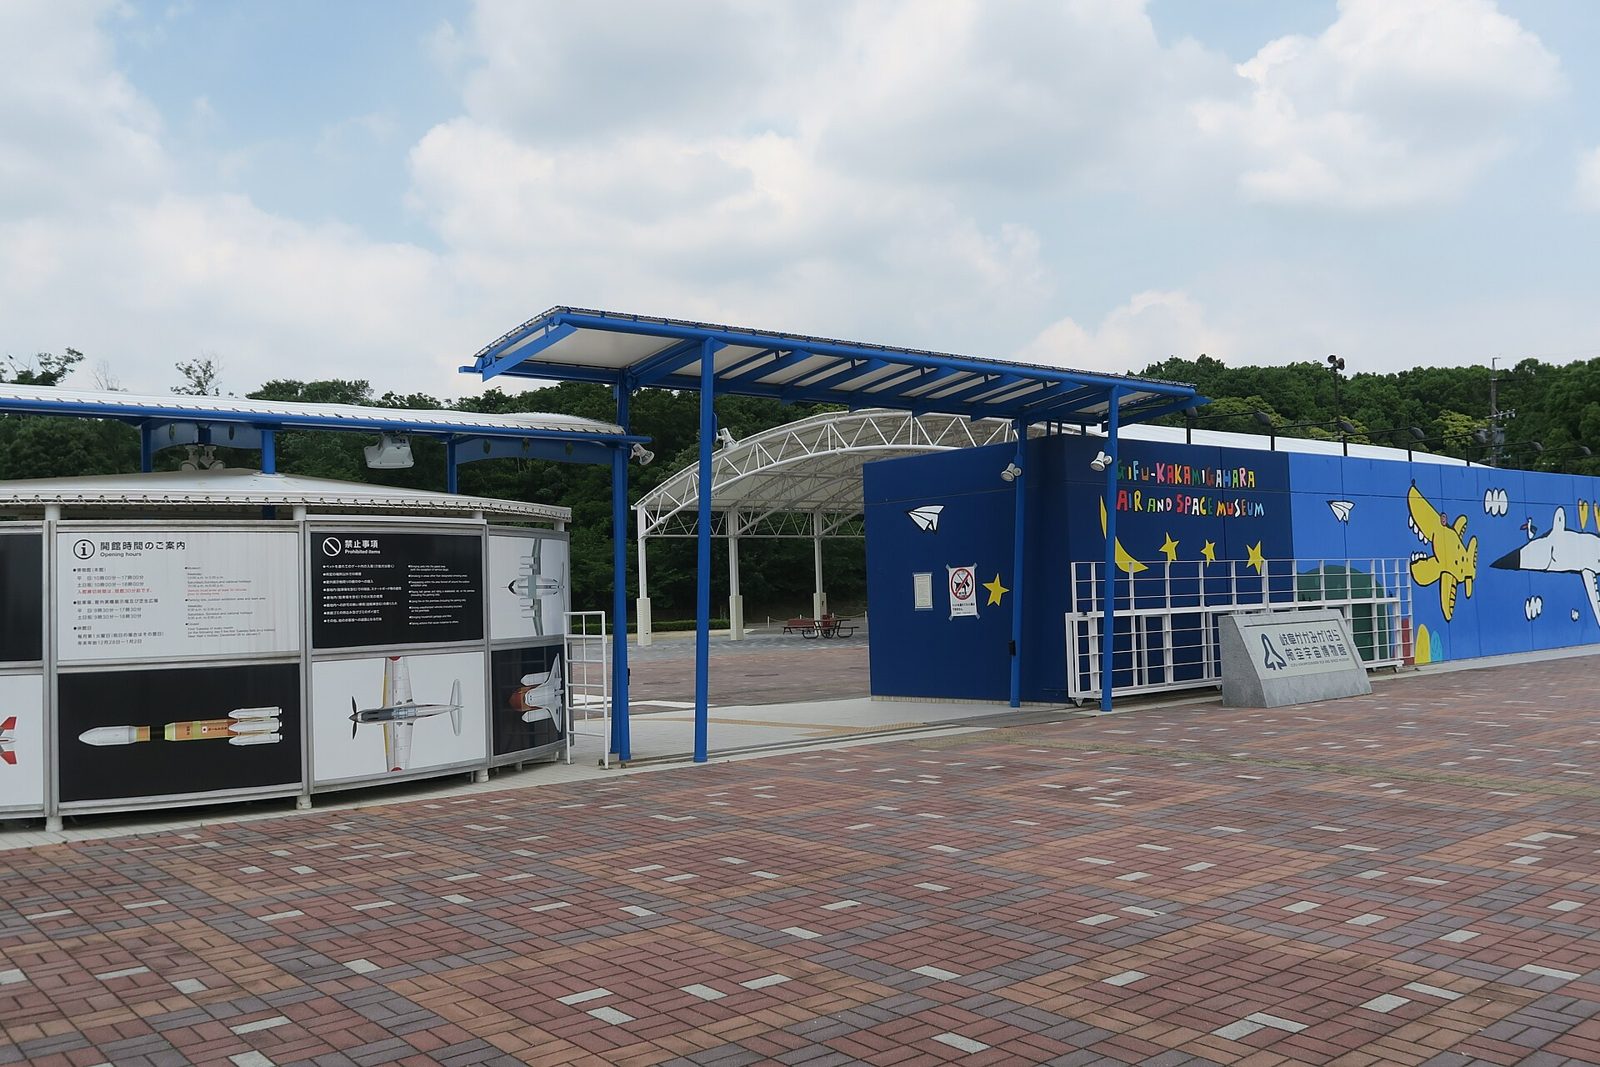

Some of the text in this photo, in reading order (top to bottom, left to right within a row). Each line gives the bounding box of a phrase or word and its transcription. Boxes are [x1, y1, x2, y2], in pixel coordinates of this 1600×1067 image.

[1116, 489, 1265, 518] AIR AND SPACE MUSEUM
[100, 541, 186, 551] 開館時間のご案内
[345, 540, 378, 549] 禁止事項
[1279, 629, 1341, 646] 岐阜かかみがはら
[1285, 643, 1347, 661] 航空宇宙博物館
